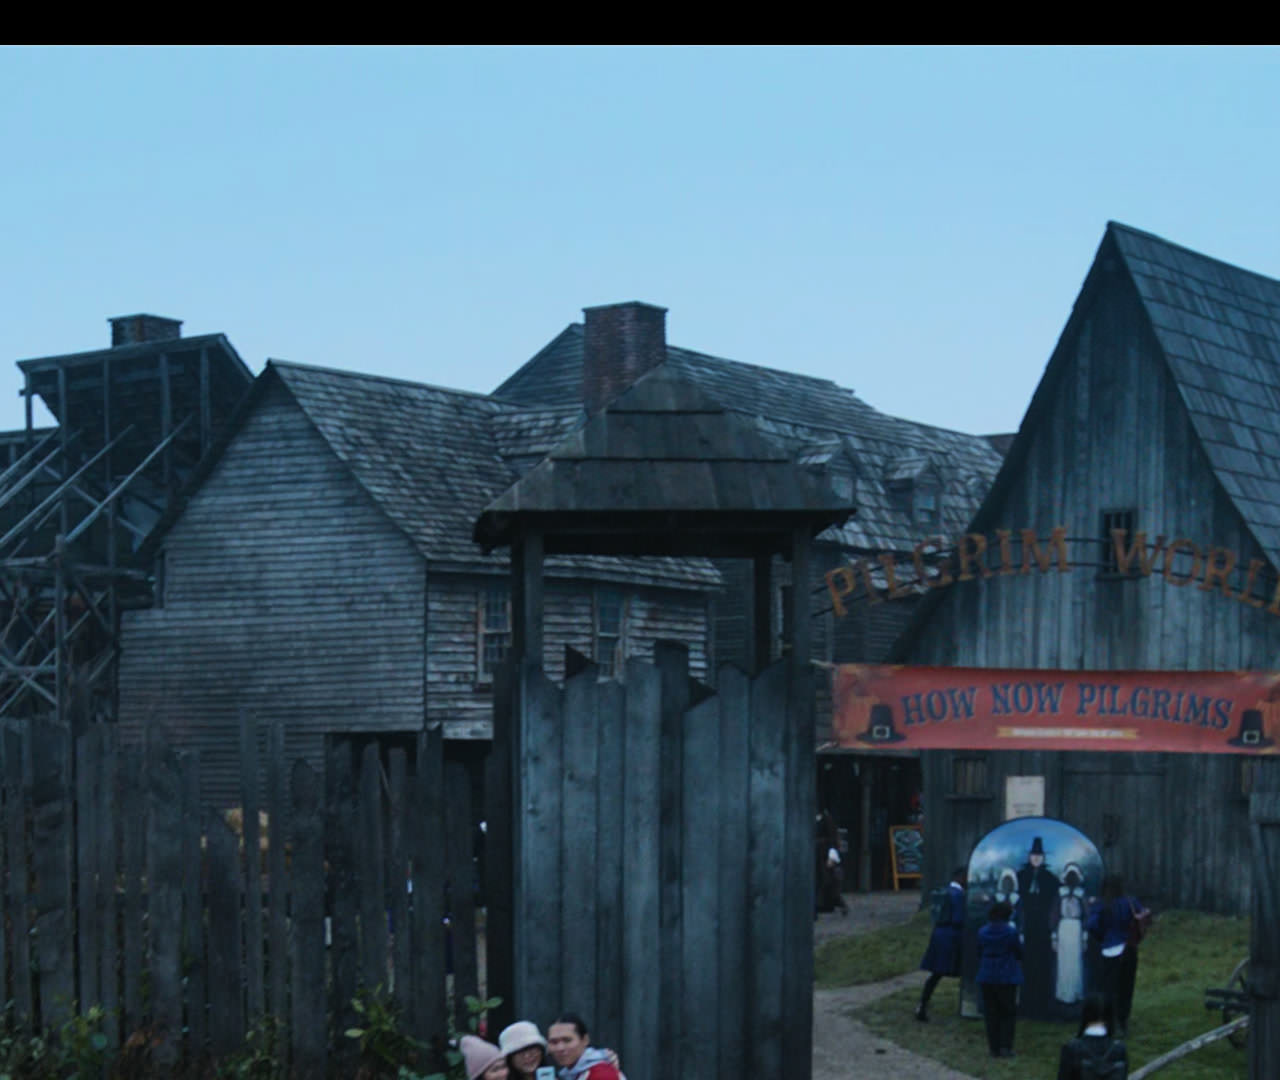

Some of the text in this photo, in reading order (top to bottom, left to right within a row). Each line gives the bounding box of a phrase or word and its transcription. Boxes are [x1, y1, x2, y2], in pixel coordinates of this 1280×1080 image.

[824, 526, 1071, 617] PILGRIM
[902, 682, 1233, 730] HOW NOW PILGRIMS
